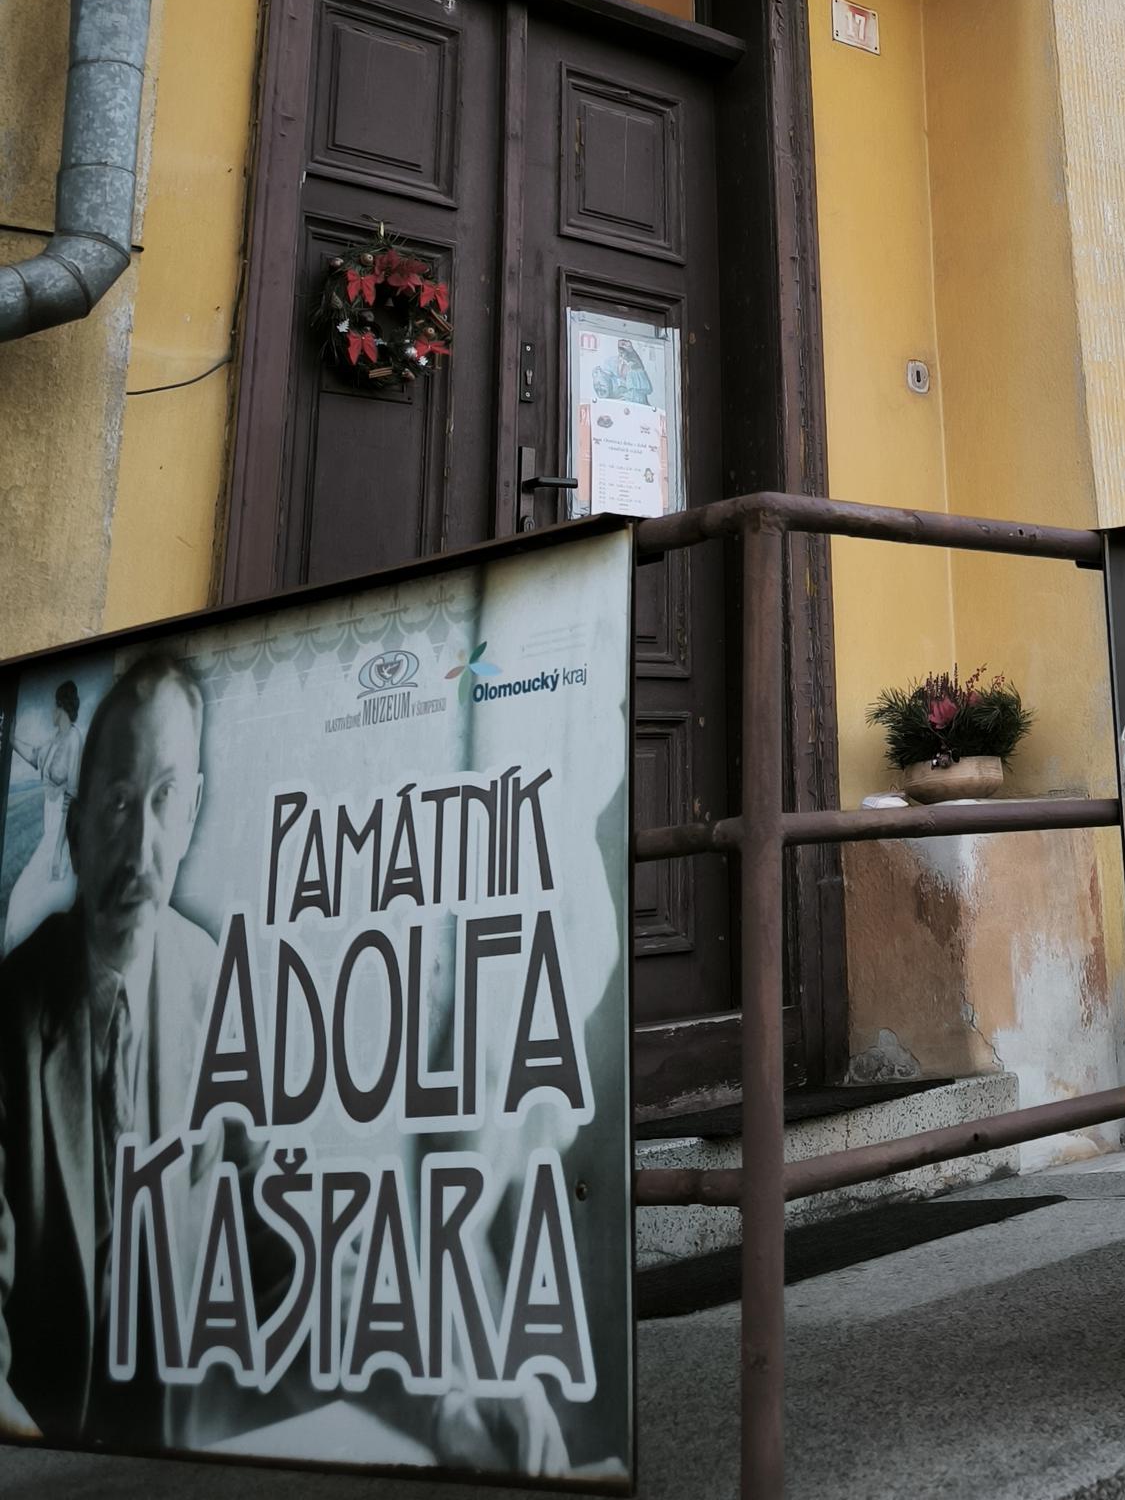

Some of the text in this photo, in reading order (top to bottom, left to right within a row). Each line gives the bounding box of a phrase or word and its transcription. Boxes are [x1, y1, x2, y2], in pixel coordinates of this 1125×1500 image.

[362, 690, 412, 727] MUZEUM
[473, 663, 588, 703] Olomoucký kraj
[265, 765, 556, 926] PAMÁTNÍK
[192, 910, 587, 1132] ADOLFA
[114, 1134, 588, 1385] KAŠPARA
